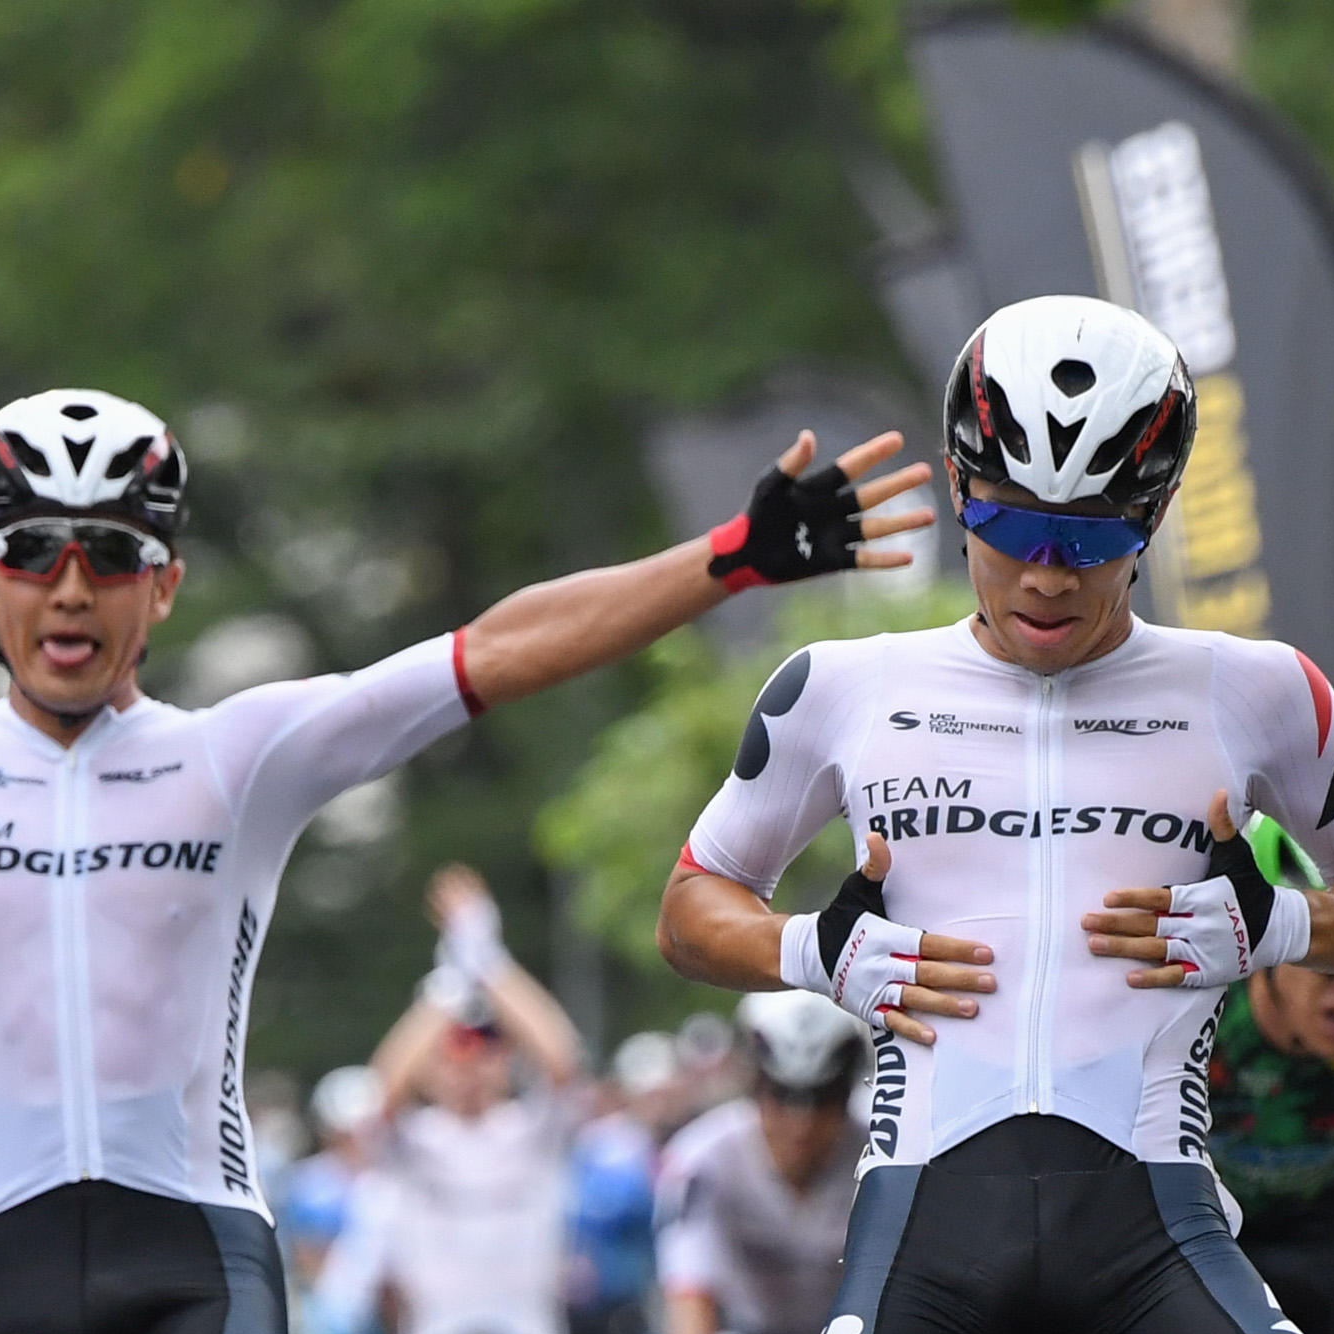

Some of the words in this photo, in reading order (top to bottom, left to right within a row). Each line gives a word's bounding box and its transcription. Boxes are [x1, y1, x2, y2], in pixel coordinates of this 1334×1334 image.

[929, 713, 956, 721] UCI
[929, 719, 1023, 734] CONTINENTAL
[1074, 719, 1138, 731] WAVE
[1146, 719, 1189, 731] ONE
[862, 776, 972, 809] TEAM
[869, 805, 1213, 854] BRIDGESTON
[1224, 900, 1248, 975] JAPAN
